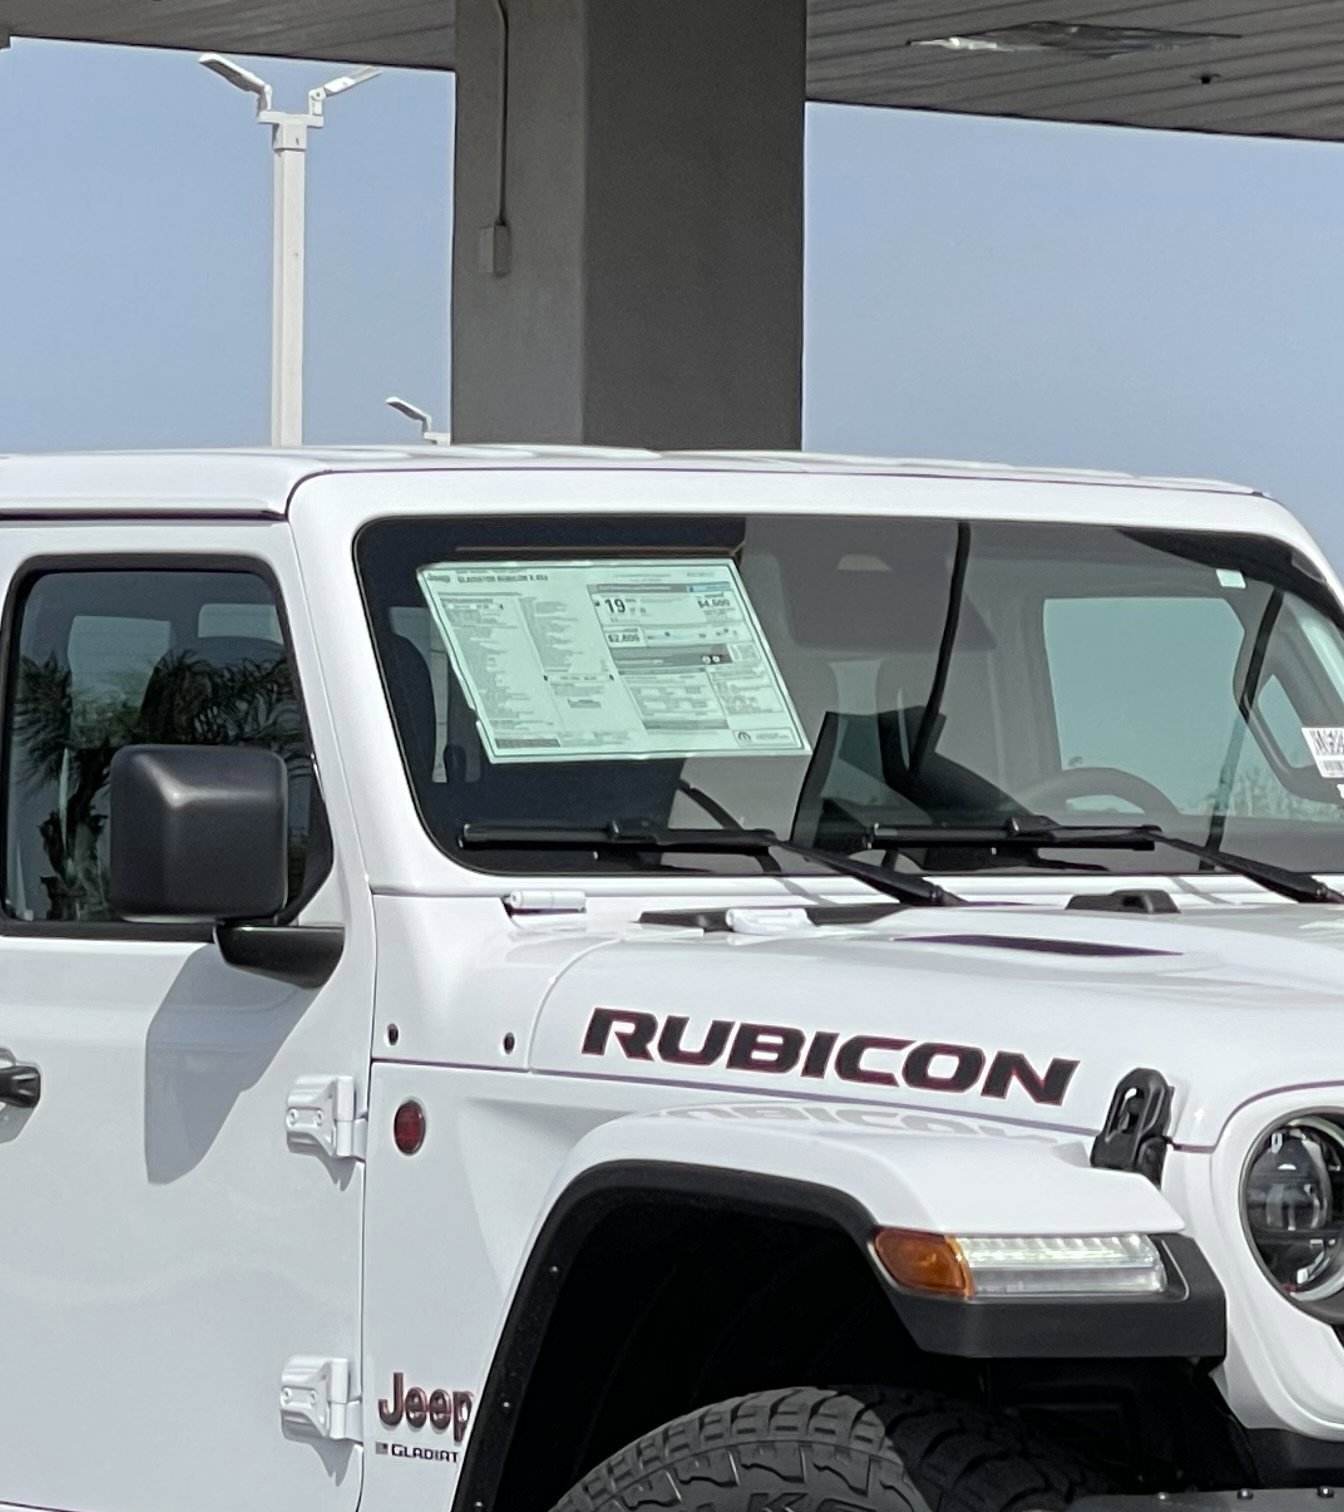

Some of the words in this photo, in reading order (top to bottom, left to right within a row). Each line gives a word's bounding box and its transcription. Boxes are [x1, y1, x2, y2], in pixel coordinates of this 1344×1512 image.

[605, 598, 626, 614] 19
[581, 1007, 1080, 1107] RUBICON
[377, 1371, 474, 1443] Jeep
[391, 1443, 460, 1463] GLADIAT
